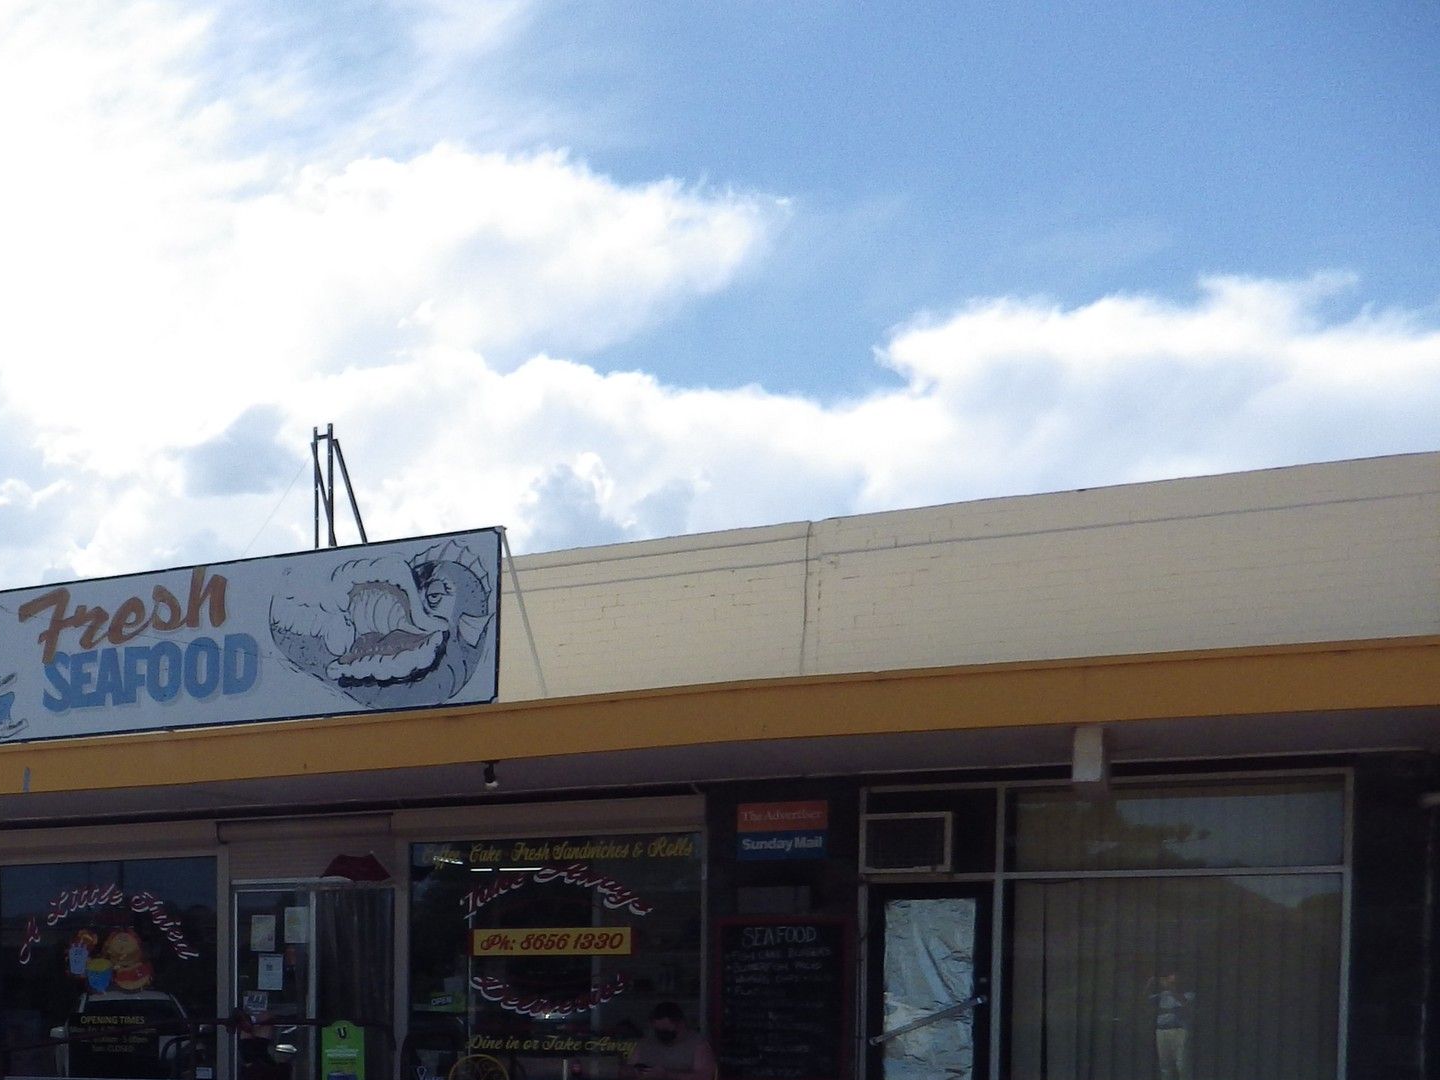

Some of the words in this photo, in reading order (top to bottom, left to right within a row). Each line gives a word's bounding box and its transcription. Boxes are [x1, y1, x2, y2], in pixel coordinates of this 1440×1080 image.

[17, 566, 228, 664] Fresh
[41, 631, 261, 713] SEAFOOD
[741, 811, 763, 821] The
[764, 809, 823, 820] Advertiser
[469, 843, 502, 862] Cake
[511, 841, 551, 861] Fresh
[552, 840, 631, 861] Sandwiches
[631, 841, 643, 857] &
[646, 837, 693, 858] Rolls
[742, 837, 793, 852] Sunday
[794, 836, 823, 848] Mail
[480, 934, 517, 951] Ph:
[520, 933, 570, 951] 8656
[572, 932, 624, 950] 1330
[741, 926, 818, 948] SEAFOOD
[431, 996, 453, 1006] OPEN
[80, 1015, 118, 1025] OPENING
[118, 1015, 146, 1025] TIMES
[466, 1034, 503, 1051] Dine
[504, 1036, 521, 1050] in
[522, 1039, 539, 1051] or
[541, 1035, 583, 1052] Take
[584, 1036, 638, 1057] Away
